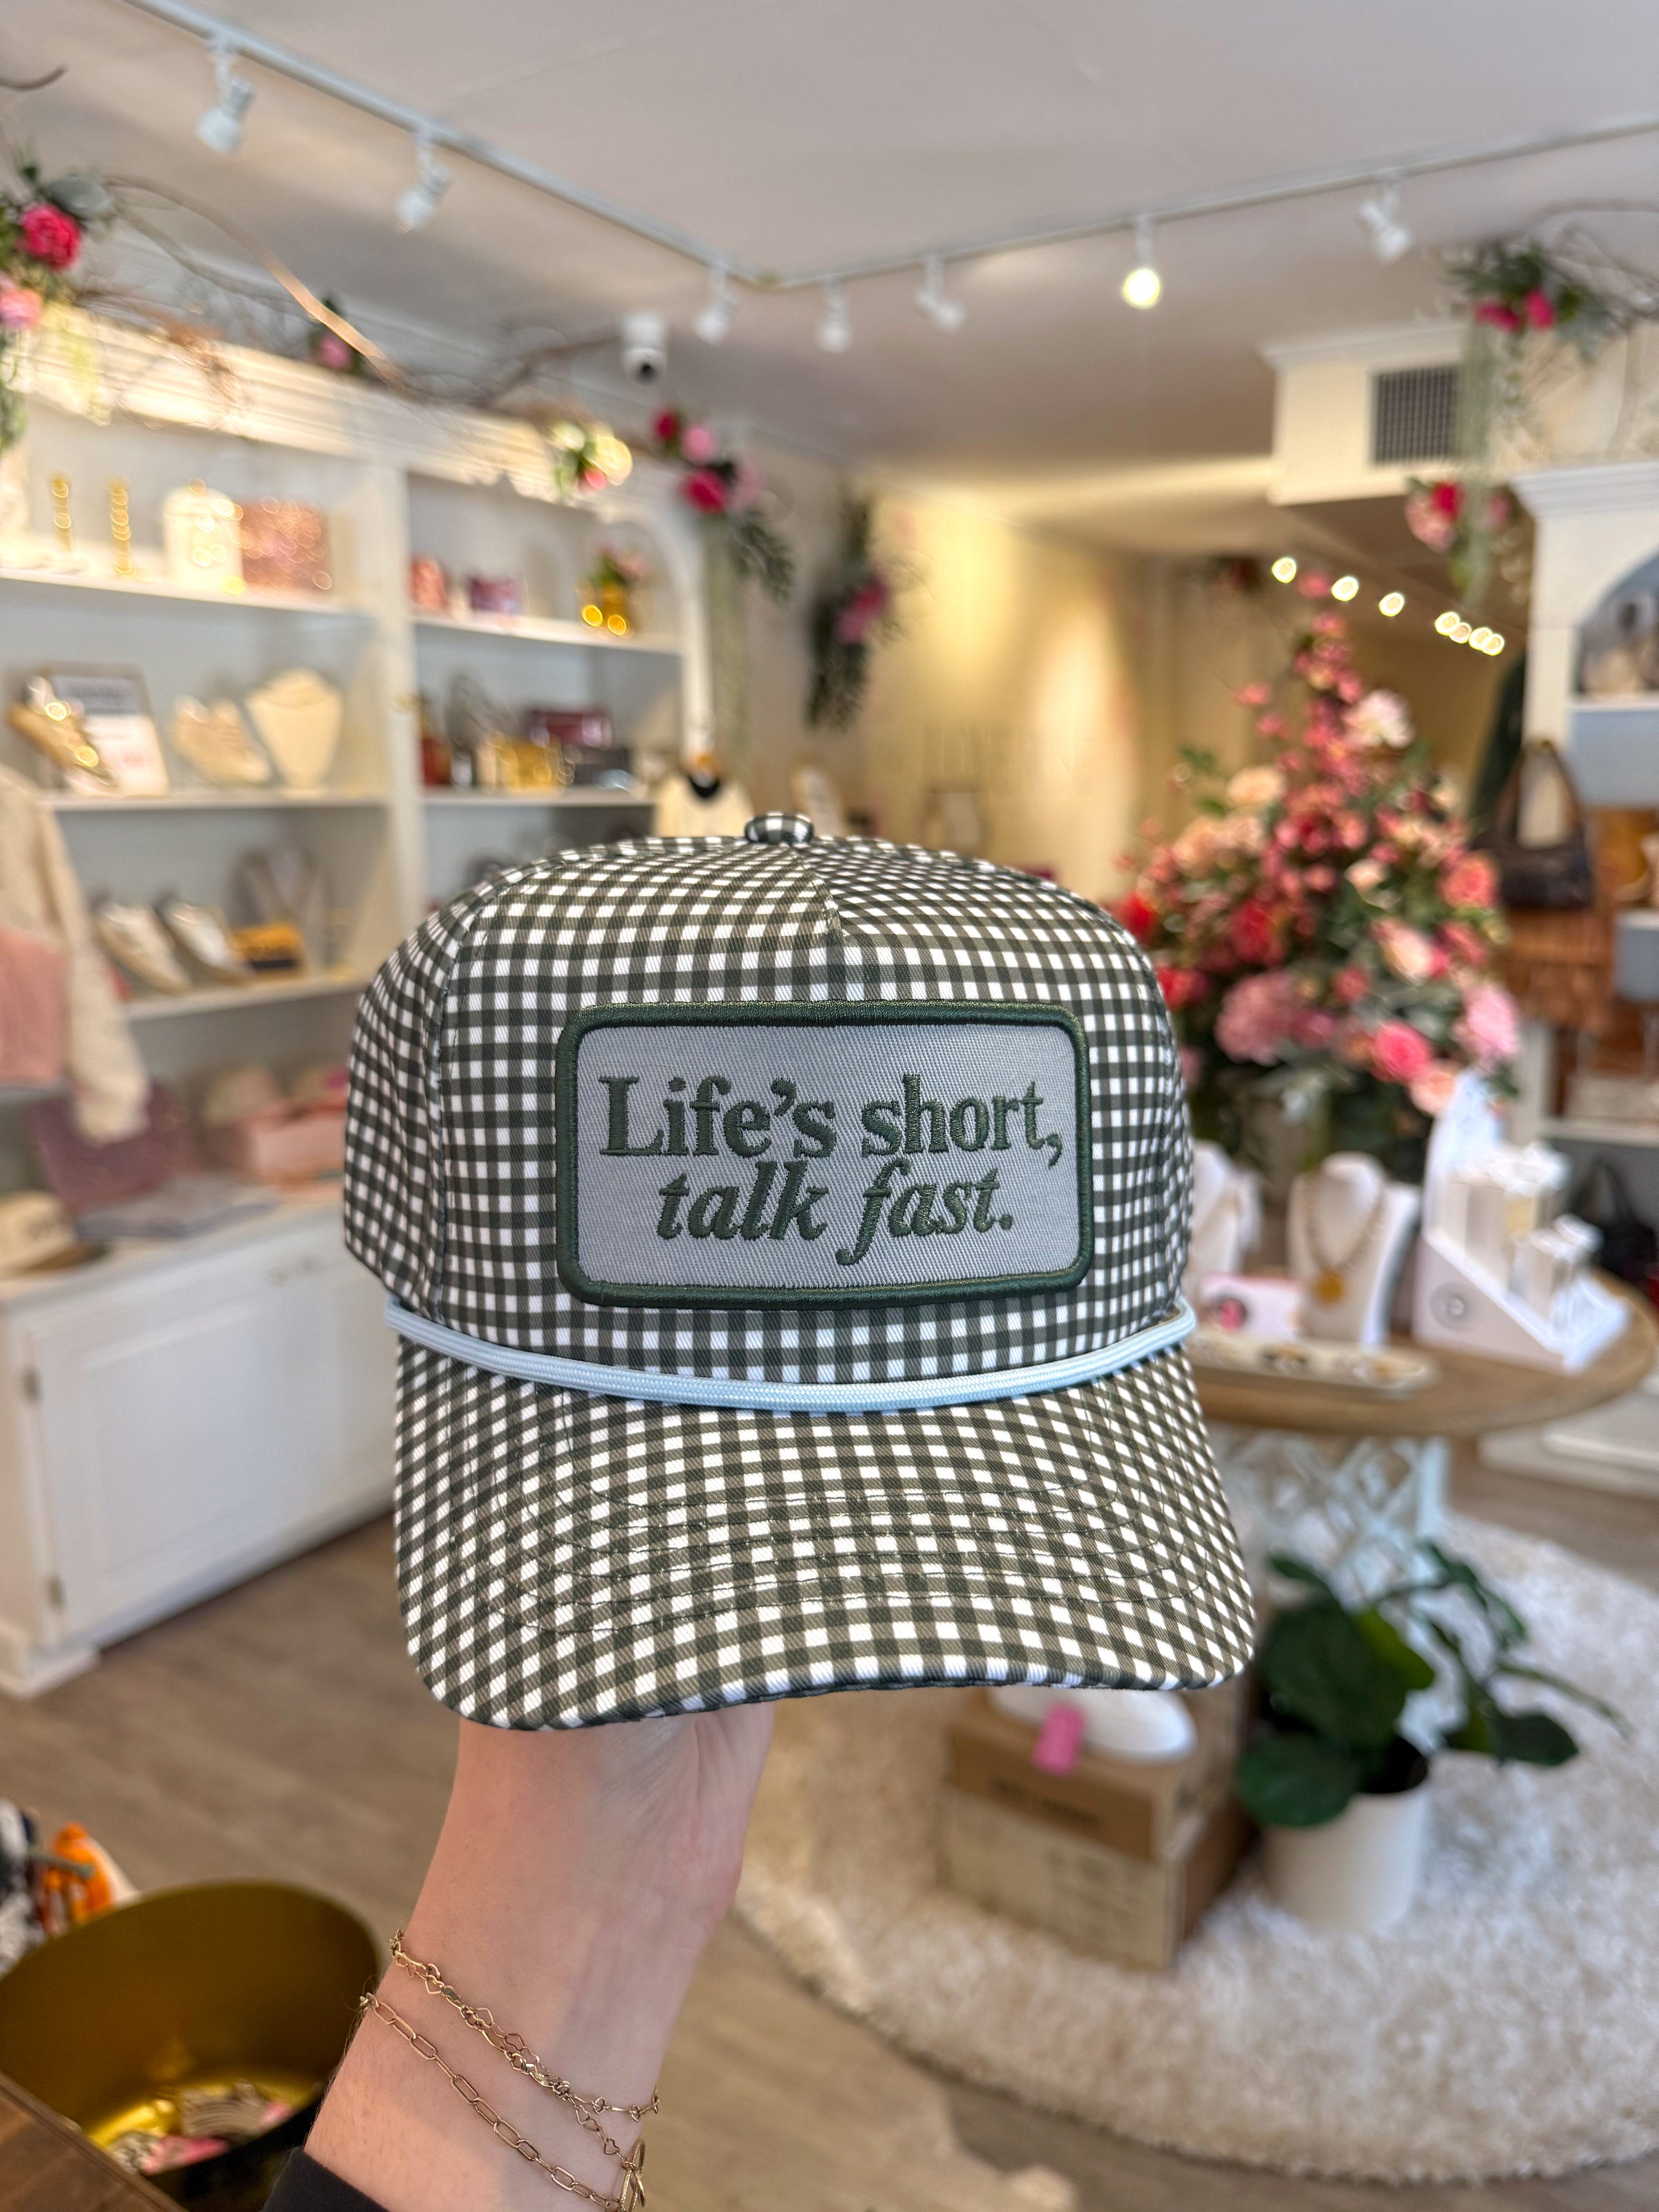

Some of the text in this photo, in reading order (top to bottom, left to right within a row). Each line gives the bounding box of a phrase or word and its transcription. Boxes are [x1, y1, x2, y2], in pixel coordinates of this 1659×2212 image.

[599, 1073, 1063, 1167] Life's short,
[656, 1157, 1013, 1266] talk fast.
